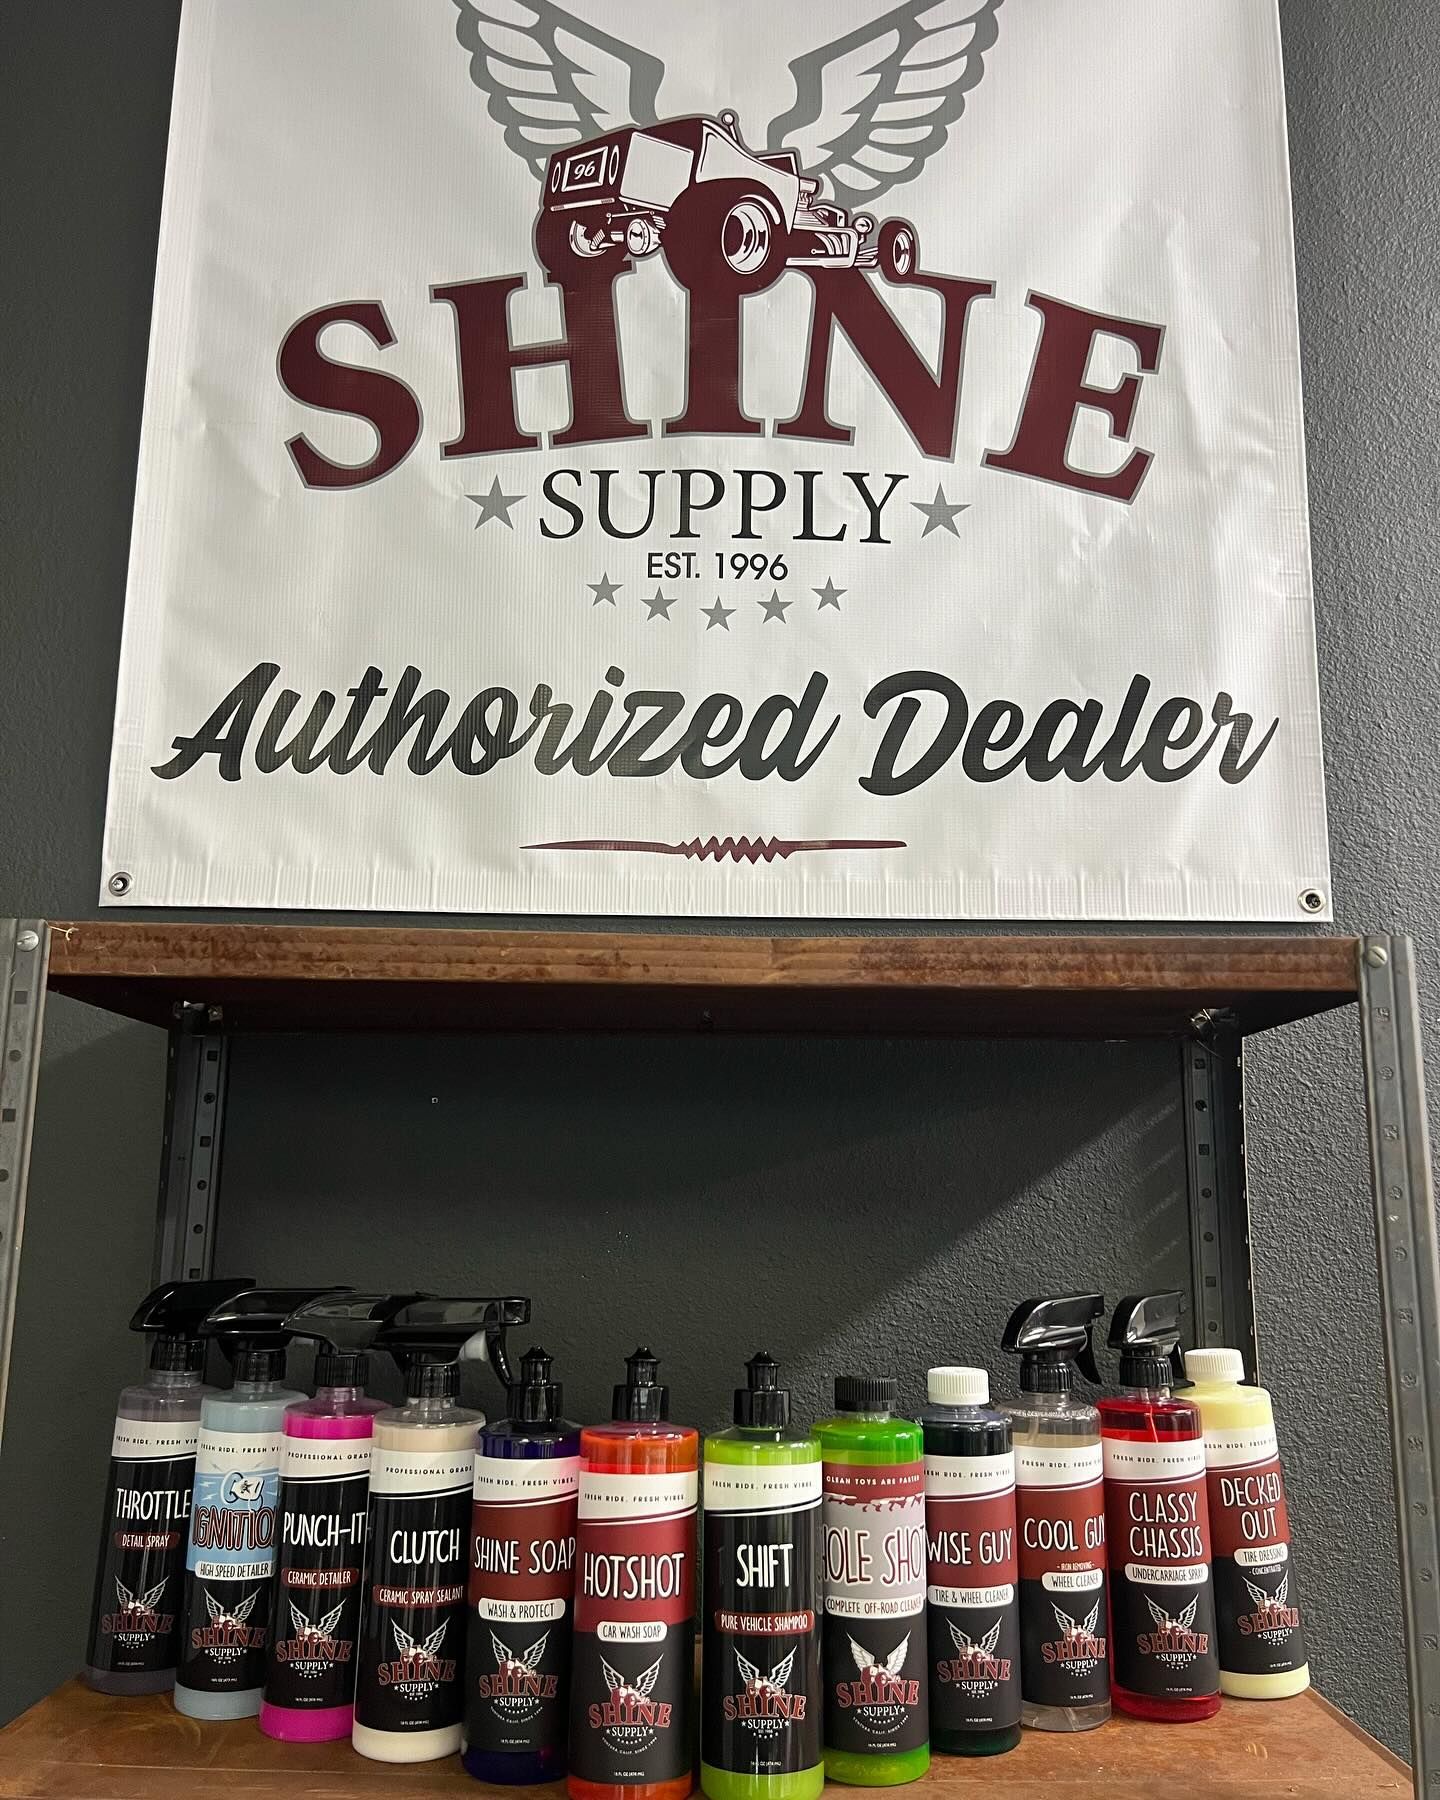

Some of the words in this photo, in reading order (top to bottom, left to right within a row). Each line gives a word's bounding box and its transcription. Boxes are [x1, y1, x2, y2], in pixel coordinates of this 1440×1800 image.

[574, 160, 596, 181] 96
[276, 269, 1167, 505] SHINE
[538, 468, 910, 545] SUPPLY
[647, 552, 700, 580] EST.
[715, 552, 789, 581] 1996
[150, 662, 841, 783] Authorized
[858, 670, 1281, 797] Dealer
[287, 1451, 343, 1461] PROFESSIONAL
[386, 1466, 445, 1475] PROFESSIONAL
[826, 1476, 850, 1485] CLEAN
[855, 1477, 877, 1486] TOYS
[880, 1476, 896, 1485] ARE
[522, 1478, 548, 1487] FRESH
[1220, 1472, 1281, 1507] DECKED
[116, 1488, 192, 1520] THROTTLE
[1129, 1491, 1197, 1523] CLASSY
[283, 1511, 366, 1547] PUNCH-IT
[1023, 1517, 1079, 1551] COOL
[1241, 1507, 1277, 1541] OUT
[122, 1534, 144, 1548] DETAIL
[146, 1534, 171, 1548] SPRAY
[390, 1528, 460, 1565] CLUTCH
[925, 1530, 972, 1565] WISE
[979, 1527, 1012, 1564] GUY
[1129, 1525, 1203, 1559] CHASSIS
[474, 1536, 520, 1575] SHINE
[528, 1536, 576, 1575] SOAP
[736, 1543, 794, 1588] SHIFT
[1243, 1551, 1258, 1563] TIRE
[200, 1565, 215, 1577] HIGH
[215, 1565, 236, 1578] SPEED
[237, 1563, 269, 1578] DETAILER
[287, 1570, 317, 1585] CERAMIC
[319, 1570, 351, 1586] DETAILER
[583, 1552, 685, 1600] HOTSHOT
[1132, 1567, 1187, 1582] UNDERCARRIAGE
[1051, 1575, 1074, 1589] WHEEL
[379, 1588, 409, 1604] CERAMIC
[411, 1589, 435, 1605] SPRAY
[436, 1585, 464, 1603] SEALANT
[935, 1589, 949, 1603] TIRE
[951, 1591, 957, 1604] &
[959, 1591, 982, 1604] WHEEL
[487, 1602, 508, 1618] WASH
[509, 1604, 517, 1619] &
[518, 1602, 555, 1618] PROTECT
[827, 1597, 861, 1614] COMPLETE
[864, 1599, 899, 1615] OFF-ROAD
[102, 1612, 175, 1633] SHINE
[602, 1624, 617, 1638] CAR
[619, 1625, 641, 1639] WASH
[643, 1624, 662, 1639] SOAP
[721, 1613, 738, 1629] PURE
[740, 1615, 773, 1632] VEHICLE
[774, 1612, 808, 1632] SHAMPOO
[1237, 1608, 1300, 1635] SHINE
[117, 1632, 151, 1642] SUPPLY
[191, 1626, 267, 1649] SHINE
[1137, 1632, 1208, 1654] SHINE
[1262, 1628, 1290, 1640] SUPPLY
[209, 1647, 243, 1657] SUPPLY
[275, 1639, 353, 1662] SHINE
[1041, 1638, 1106, 1664] SHINE
[1160, 1653, 1193, 1662] SUPPLY
[294, 1661, 329, 1671] SUPPLY
[377, 1660, 457, 1686] SHINE
[937, 1658, 1012, 1682] SHINE
[1065, 1658, 1095, 1670] SUPPLY
[400, 1681, 434, 1693] SUPPLY
[478, 1673, 559, 1699] SHINE
[836, 1680, 920, 1708] SHINE
[961, 1680, 994, 1690] SUPPLY
[499, 1697, 534, 1707] SUPPLY
[723, 1694, 807, 1720] SHINE
[863, 1705, 901, 1717] SUPPLY
[588, 1702, 673, 1729] SHINE
[747, 1718, 785, 1729] SUPPLY
[611, 1726, 648, 1737] SUPPLY
